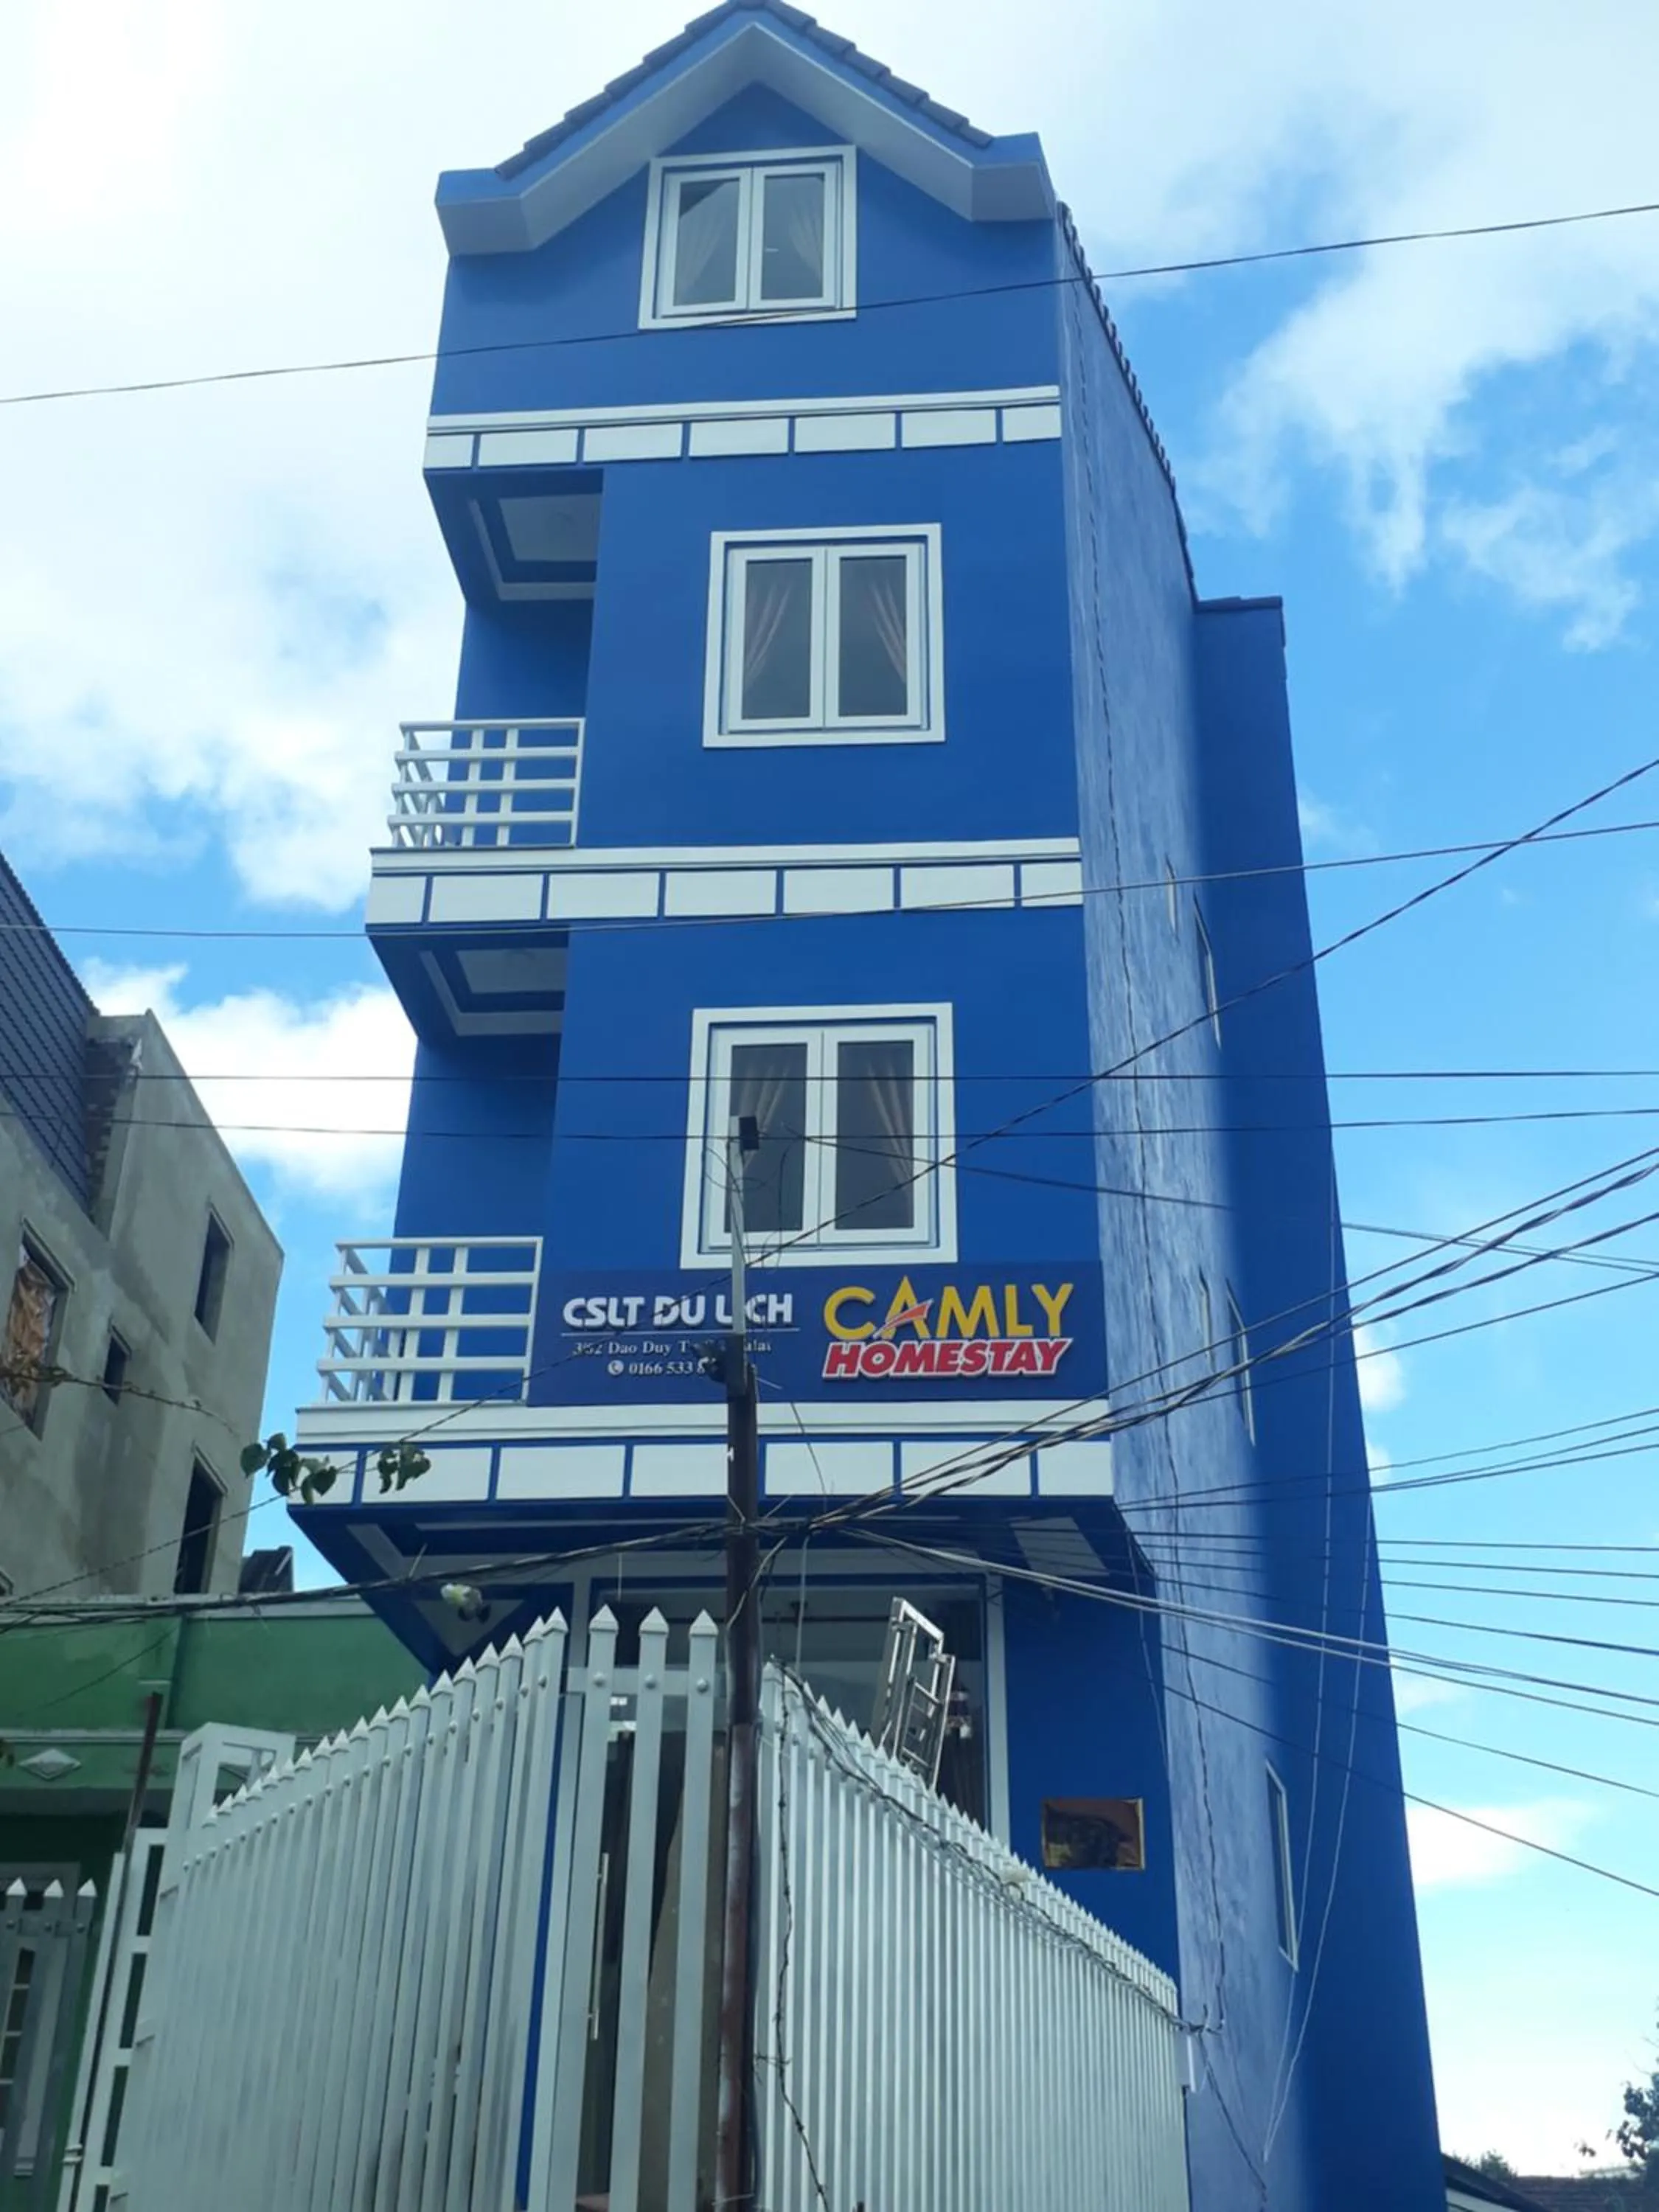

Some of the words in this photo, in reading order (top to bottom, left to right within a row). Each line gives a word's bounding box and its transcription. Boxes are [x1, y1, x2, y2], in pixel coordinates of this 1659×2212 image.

[563, 1298, 645, 1326] CSLT
[653, 1295, 706, 1325] DU
[715, 1294, 792, 1325] LCH
[824, 1276, 1074, 1340] CAMLY
[608, 1340, 638, 1354] Dao
[643, 1340, 672, 1357] Duy
[823, 1338, 1074, 1378] HOMESTAY
[629, 1362, 663, 1375] 0166
